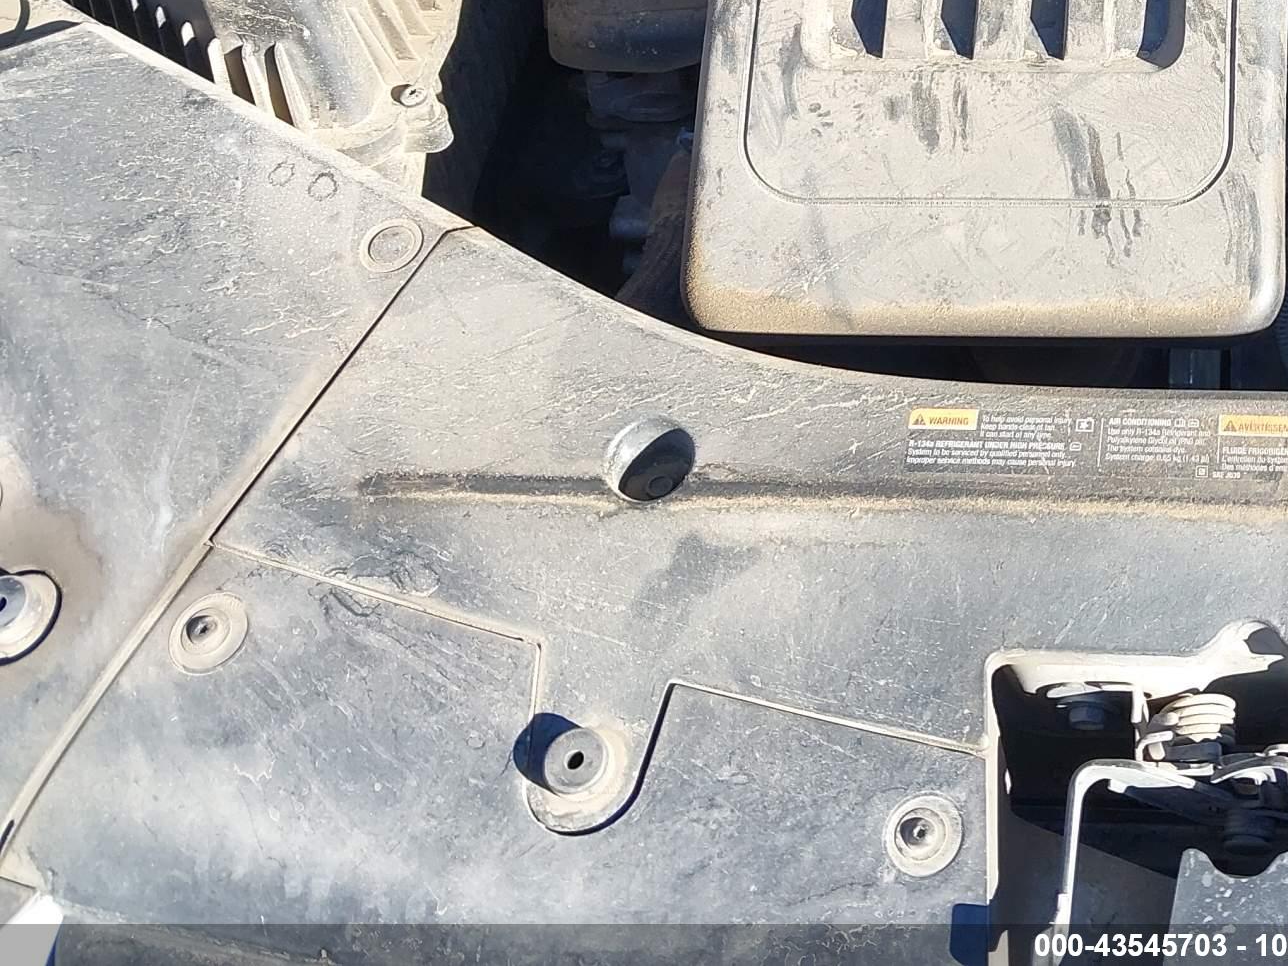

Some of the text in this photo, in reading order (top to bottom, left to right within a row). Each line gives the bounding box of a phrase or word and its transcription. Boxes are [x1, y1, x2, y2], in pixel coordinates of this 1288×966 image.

[929, 417, 969, 425] WARNING
[1025, 417, 1053, 425] personal
[1122, 418, 1172, 426] CONDITIONING
[935, 440, 983, 448] REFRIGERANT
[984, 441, 1009, 449] UNDER
[908, 448, 932, 456] System
